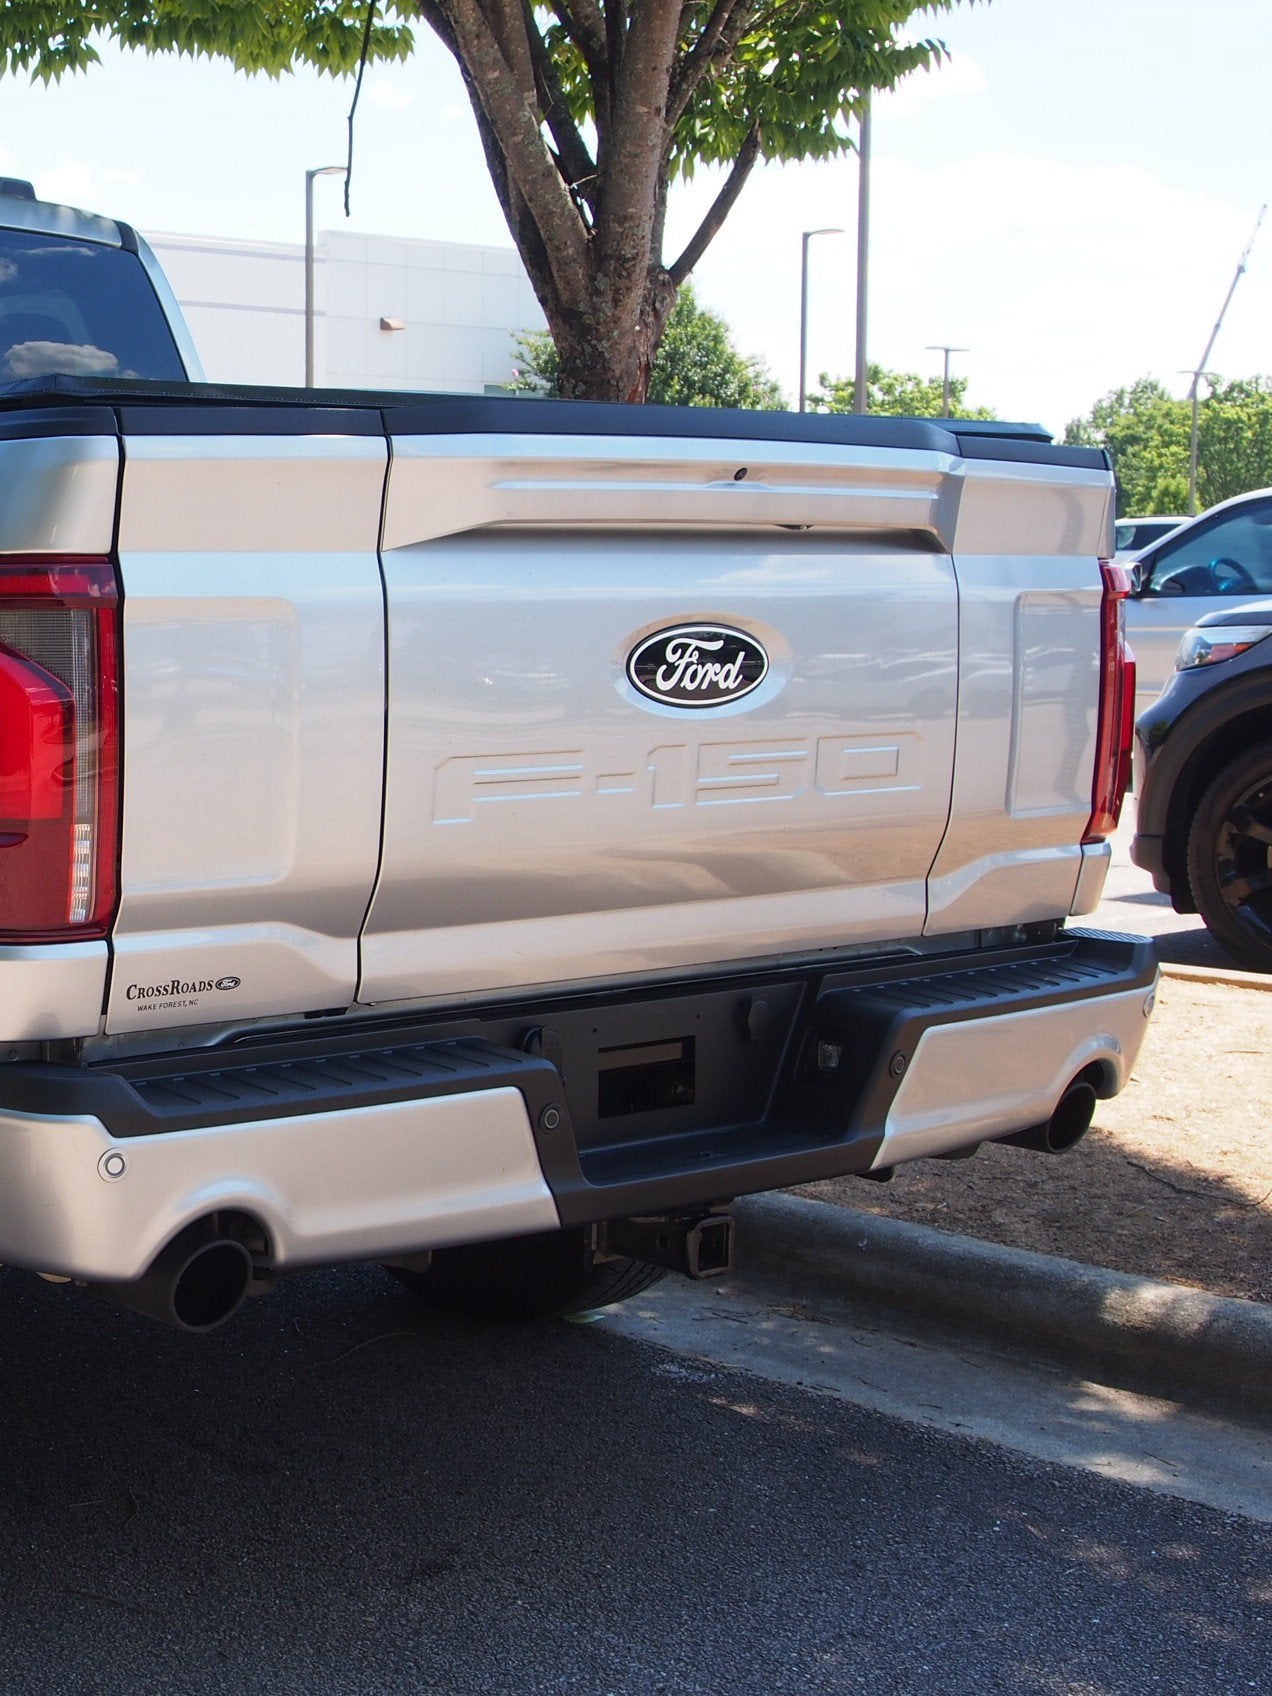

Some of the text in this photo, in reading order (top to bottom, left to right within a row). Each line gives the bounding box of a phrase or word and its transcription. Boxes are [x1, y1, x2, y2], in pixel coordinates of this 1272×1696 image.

[655, 637, 744, 692] Ford
[432, 732, 923, 824] F-150
[137, 1003, 157, 1012] WAKE
[158, 1000, 188, 1010] FOREST,
